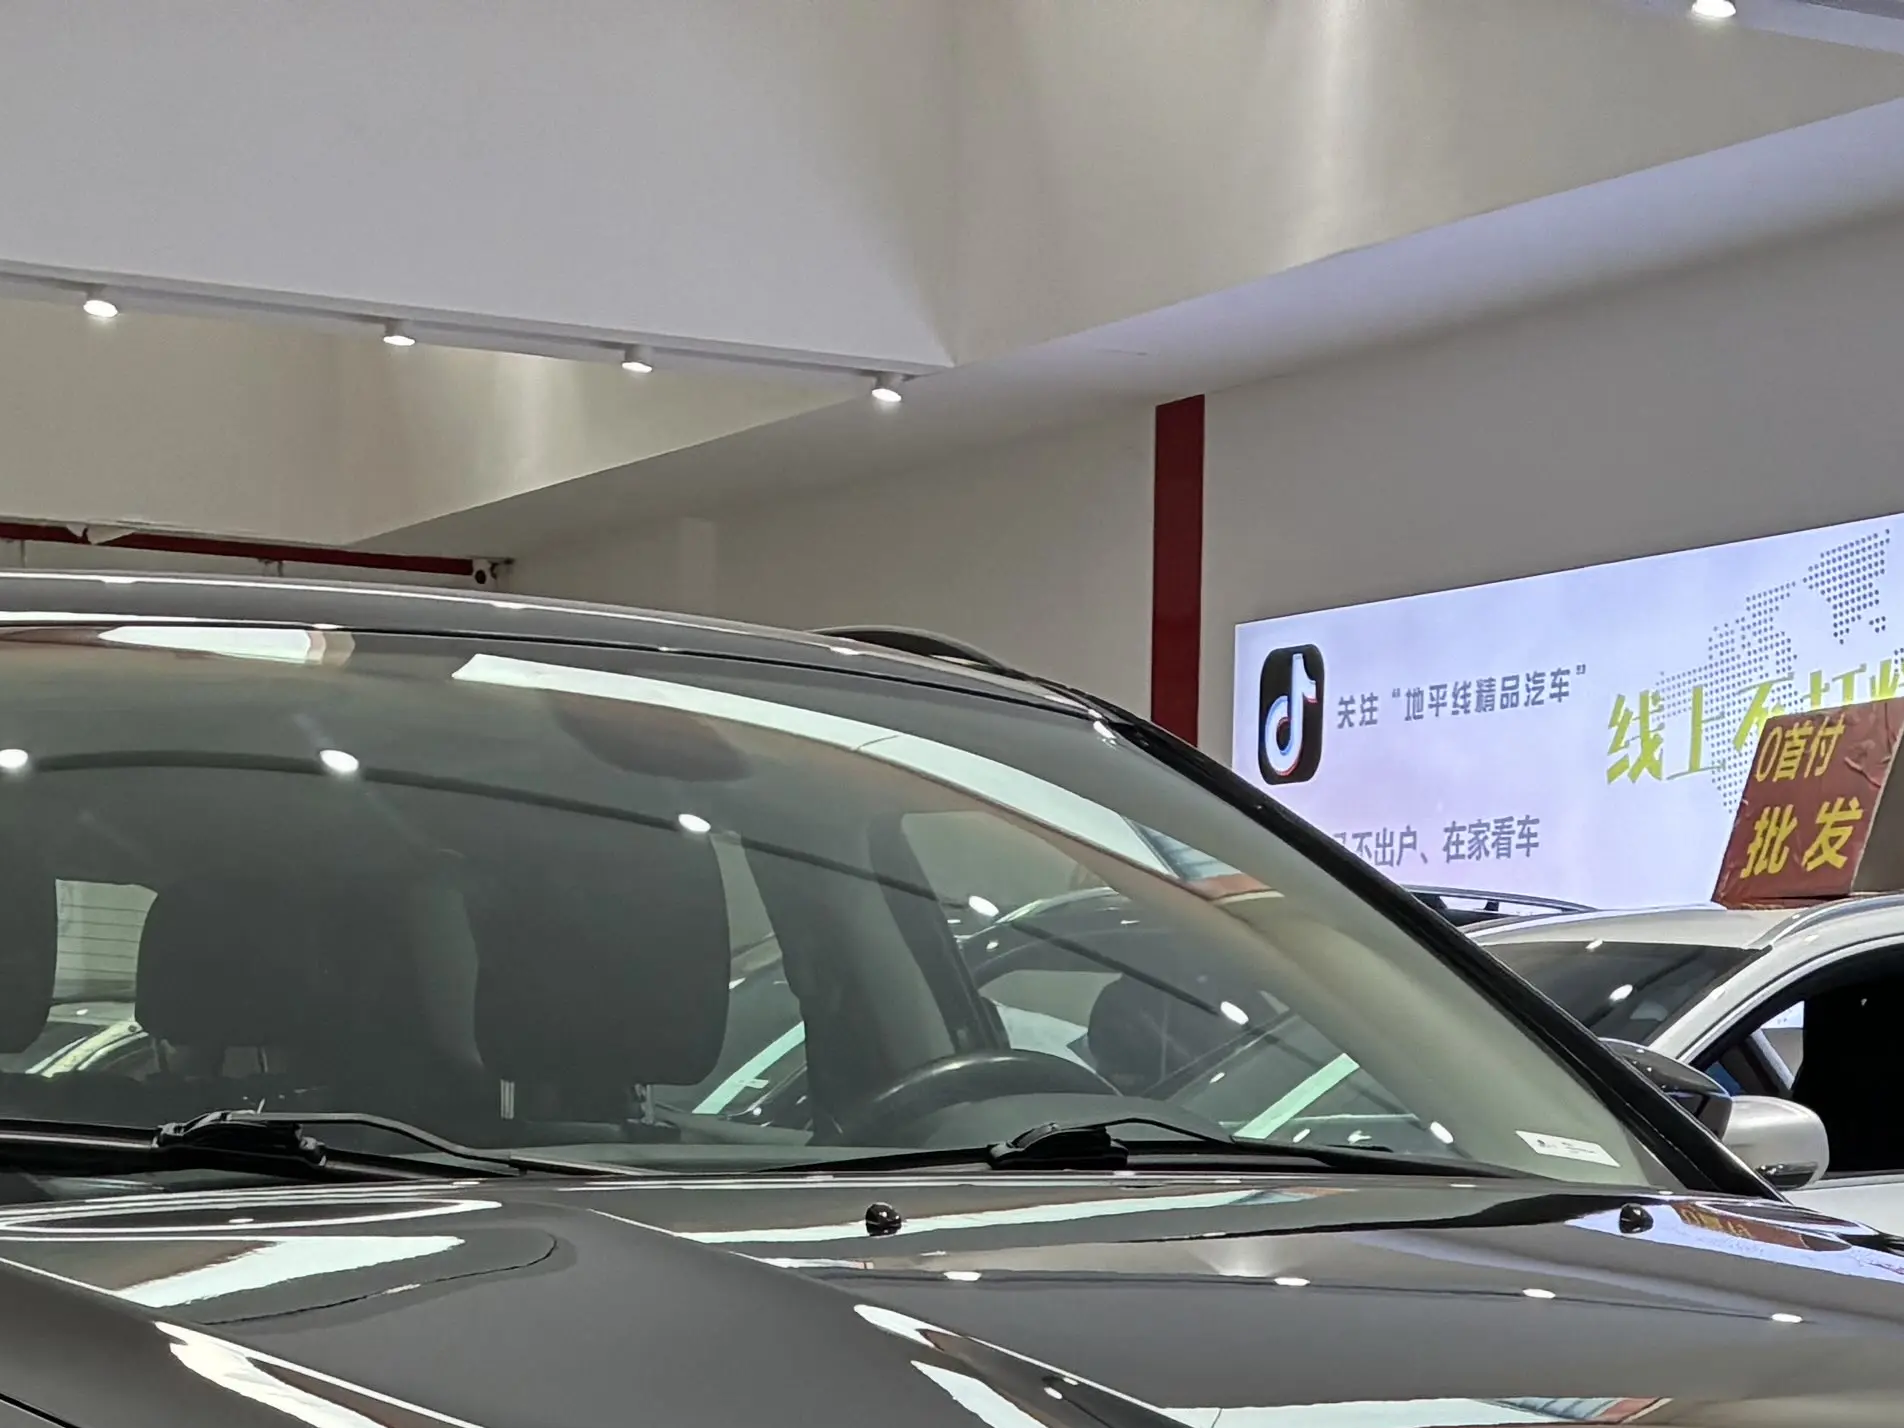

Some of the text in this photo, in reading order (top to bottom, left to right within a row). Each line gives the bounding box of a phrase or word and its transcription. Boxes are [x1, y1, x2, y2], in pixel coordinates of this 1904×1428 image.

[1755, 713, 1846, 783] 0首付
[1332, 813, 1541, 868] 不出户、在家看车
[1740, 796, 1864, 879] 批发
